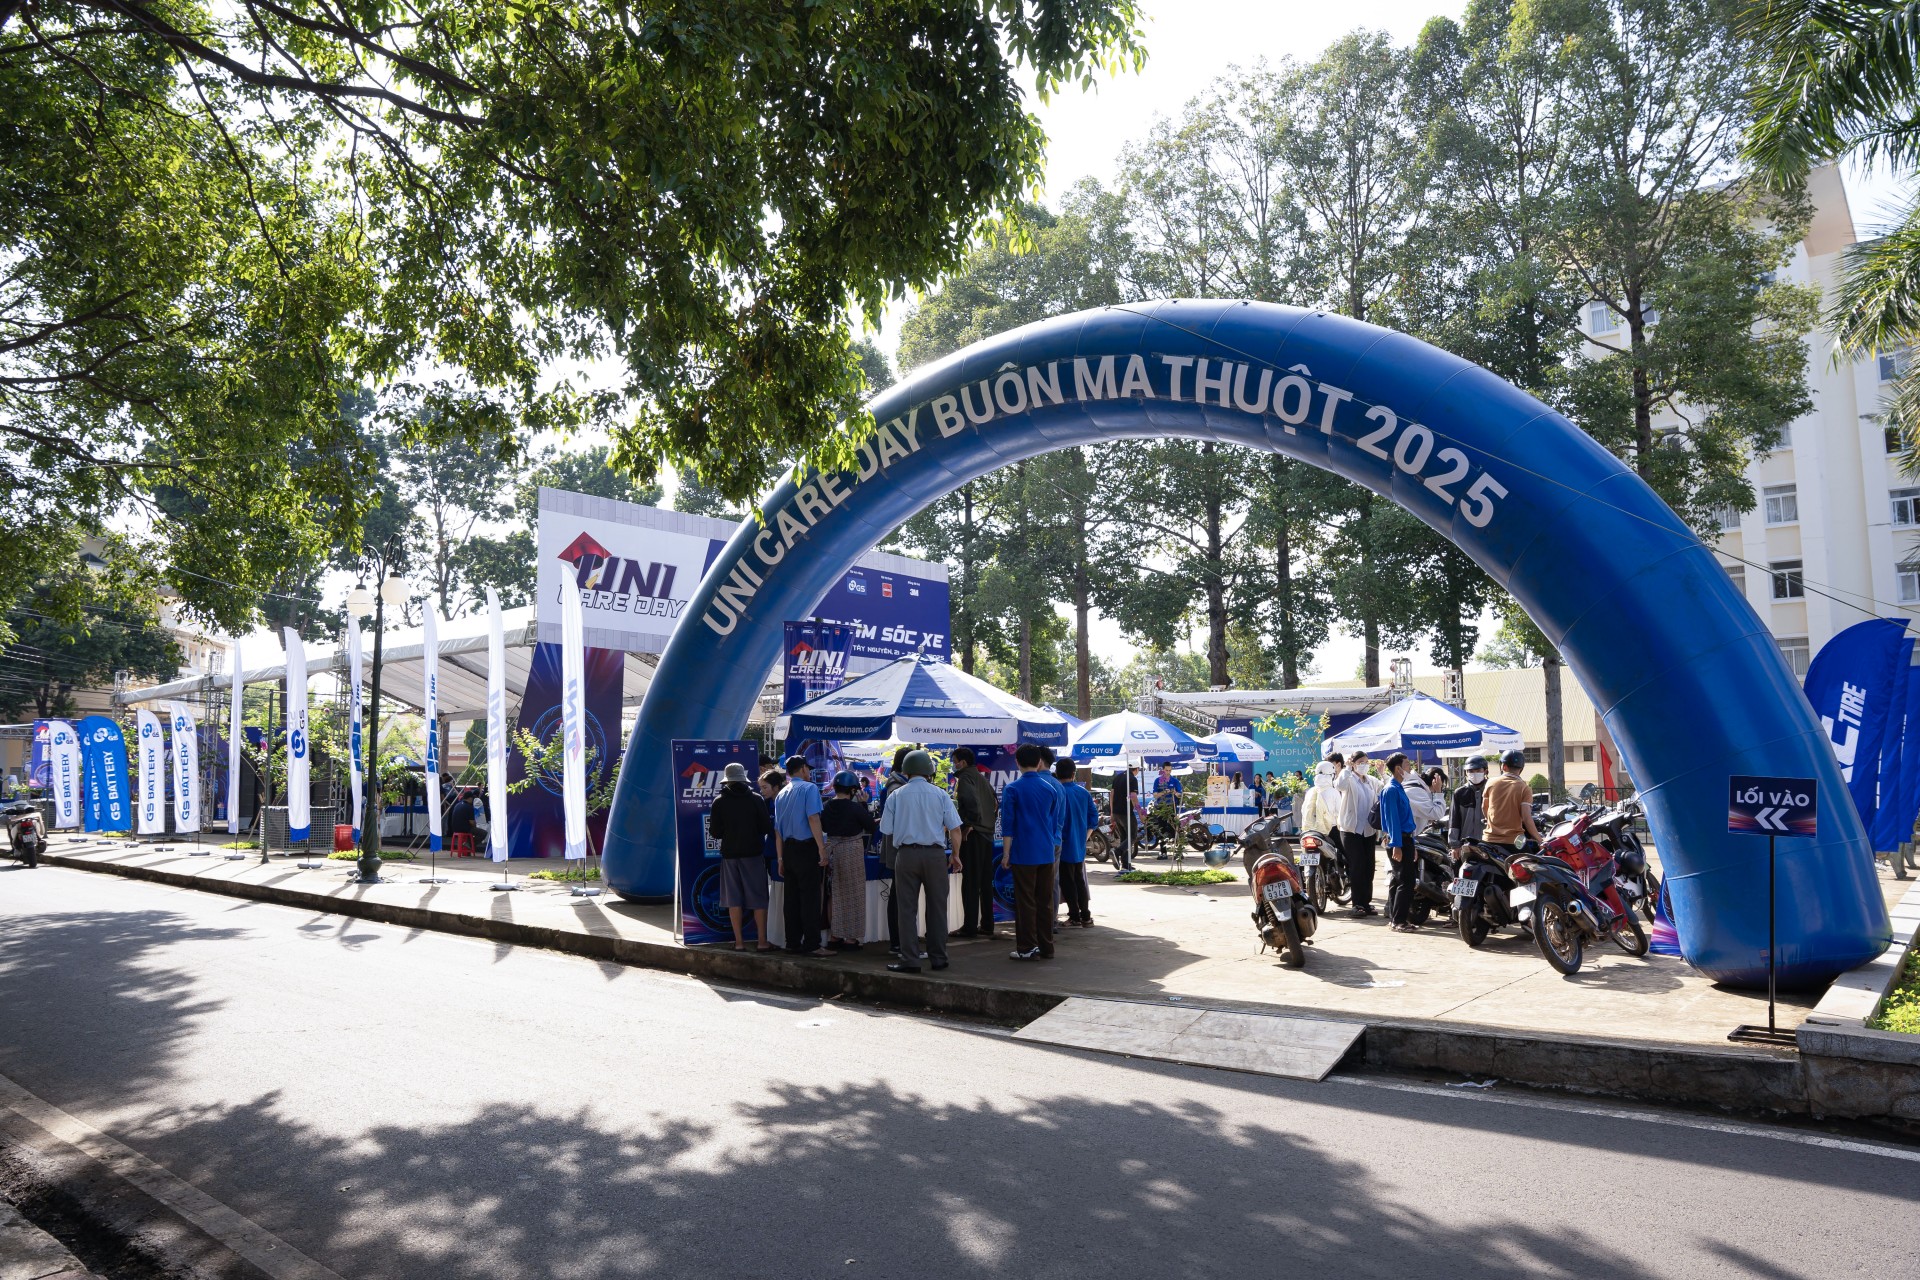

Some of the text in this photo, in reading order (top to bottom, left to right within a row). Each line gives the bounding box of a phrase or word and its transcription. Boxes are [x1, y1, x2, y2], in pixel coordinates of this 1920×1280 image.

[703, 354, 1509, 636] UNI CARE DAY BUÔN MA THUỘT 2025
[576, 554, 677, 600] UNI
[855, 585, 866, 593] GS
[909, 588, 919, 597] 3M
[557, 584, 688, 619] ARE DAY
[881, 624, 917, 646] SÓC
[920, 632, 945, 649] XE
[797, 649, 845, 667] UNI
[790, 665, 844, 676] CARE DAY
[1838, 681, 1867, 727] TIRE
[803, 725, 880, 734] www.ircvietnam.com
[1131, 730, 1159, 740] GS
[1235, 742, 1254, 750] GS
[1411, 737, 1472, 745] www.ircvietnam.com
[1269, 747, 1317, 756] AEROFLOW
[62, 753, 72, 817] GS BATTERY
[102, 750, 120, 821] GS BATTERY
[181, 742, 190, 821] GS BATTERY
[683, 788, 722, 798] CARE
[1736, 786, 1810, 807] LỐI VÀO
[146, 802, 155, 822] GS
